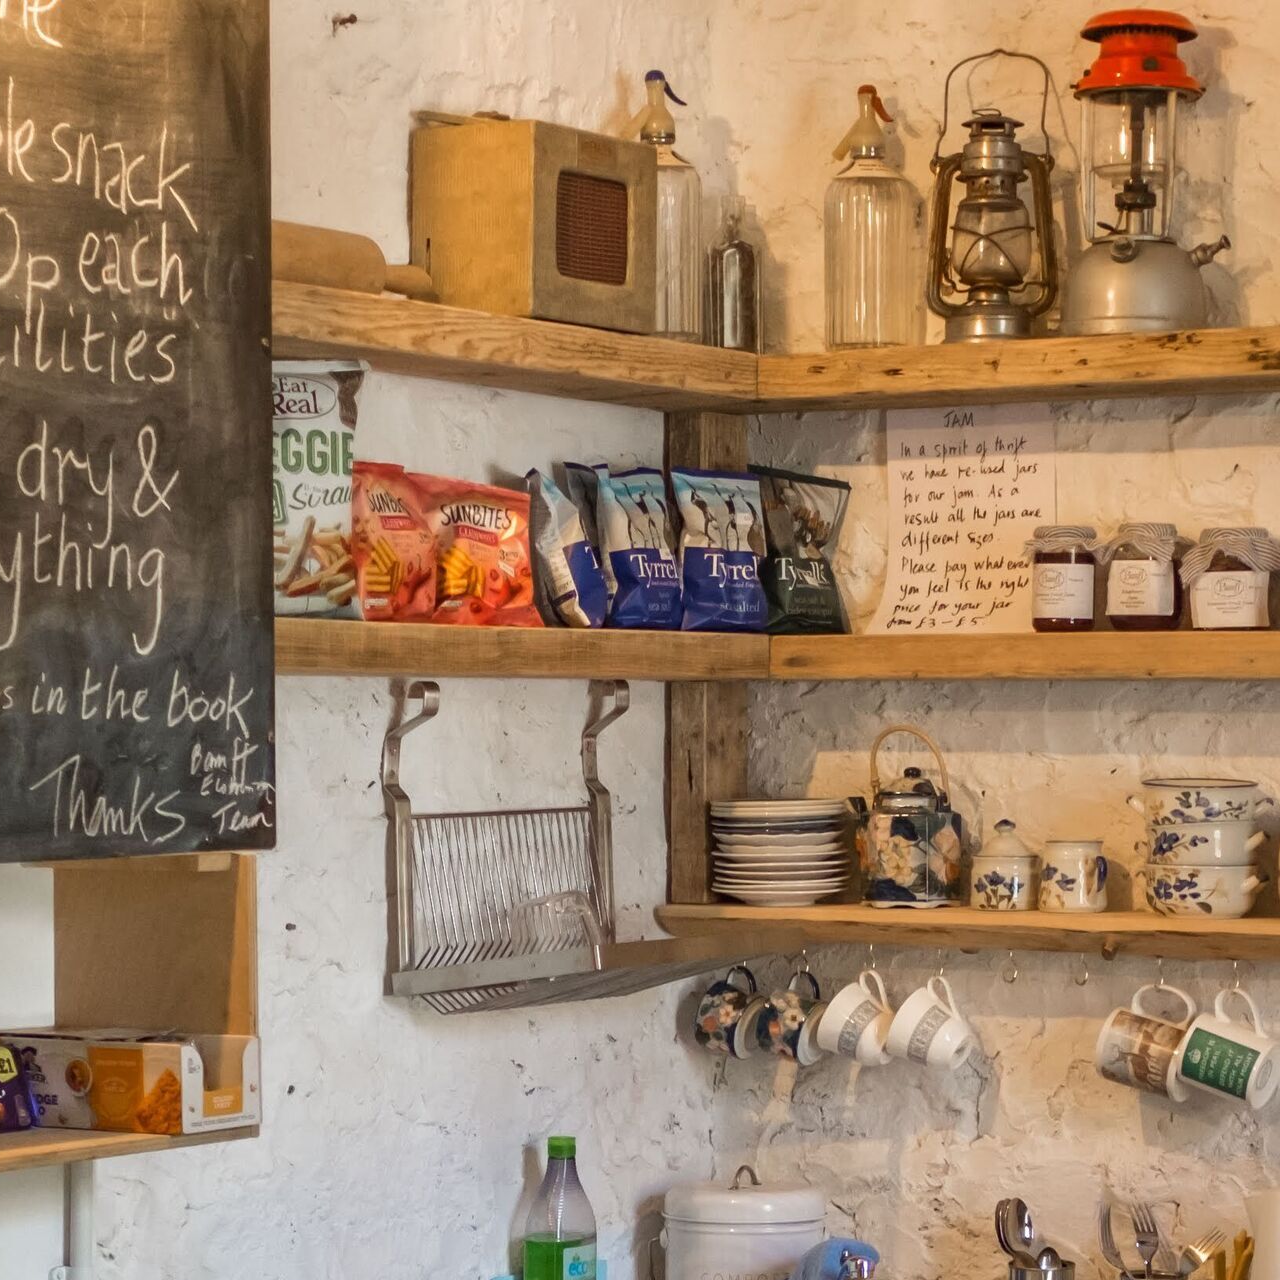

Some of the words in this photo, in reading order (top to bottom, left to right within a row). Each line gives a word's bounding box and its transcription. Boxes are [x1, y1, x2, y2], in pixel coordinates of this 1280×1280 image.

[52, 122, 197, 231] snack
[78, 221, 193, 306] each
[278, 377, 308, 393] Eat
[272, 391, 320, 415] Real
[943, 412, 974, 427] JAM
[272, 427, 354, 476] GGIE
[919, 446, 925, 455] a
[976, 445, 986, 463] of
[1013, 460, 1038, 481] jars
[18, 421, 115, 549] dry
[132, 425, 180, 517] &
[1010, 488, 1019, 496] a
[440, 502, 512, 530] SUNBITES
[948, 509, 965, 521] all
[994, 505, 1016, 526] jars
[1021, 509, 1041, 518] are
[901, 531, 959, 554] different
[902, 556, 936, 574] Please
[945, 561, 967, 579] pay
[928, 578, 949, 597] feel
[32, 671, 66, 715] in
[79, 667, 150, 723] the
[167, 675, 253, 740] book
[31, 755, 186, 846] Thanks
